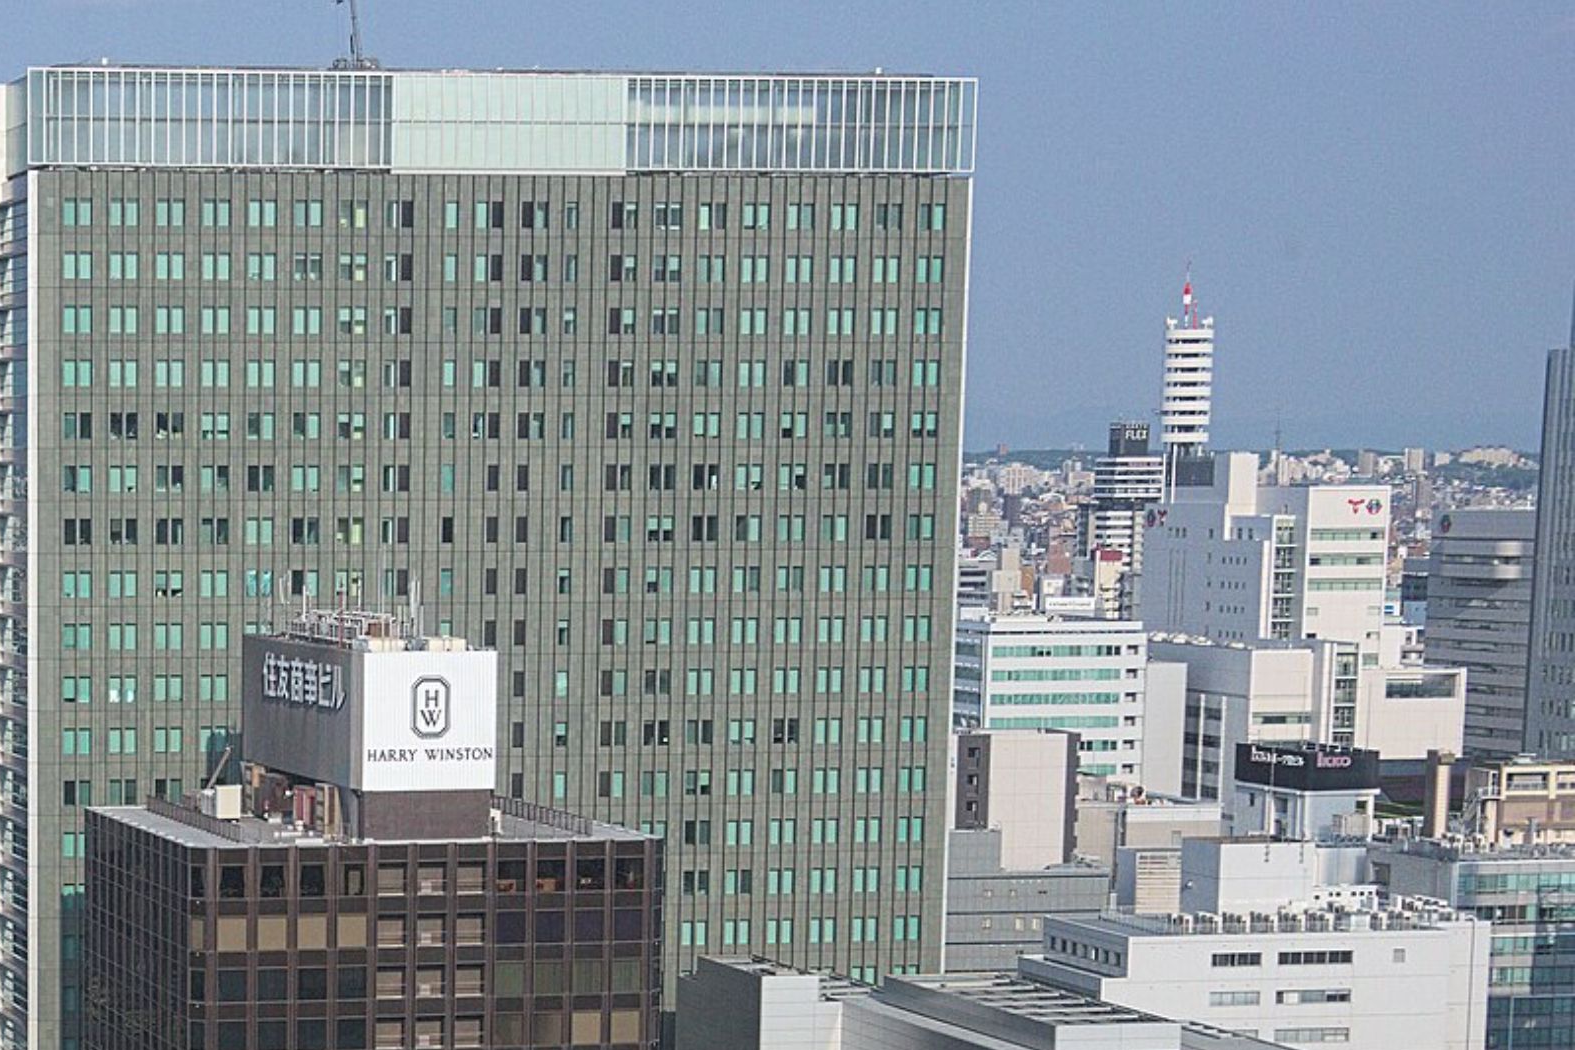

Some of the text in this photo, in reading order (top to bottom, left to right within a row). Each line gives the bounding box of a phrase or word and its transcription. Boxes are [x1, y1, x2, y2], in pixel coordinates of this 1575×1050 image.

[263, 652, 346, 710] 住友商事ビル
[367, 747, 494, 762] HARRY WINSTON
